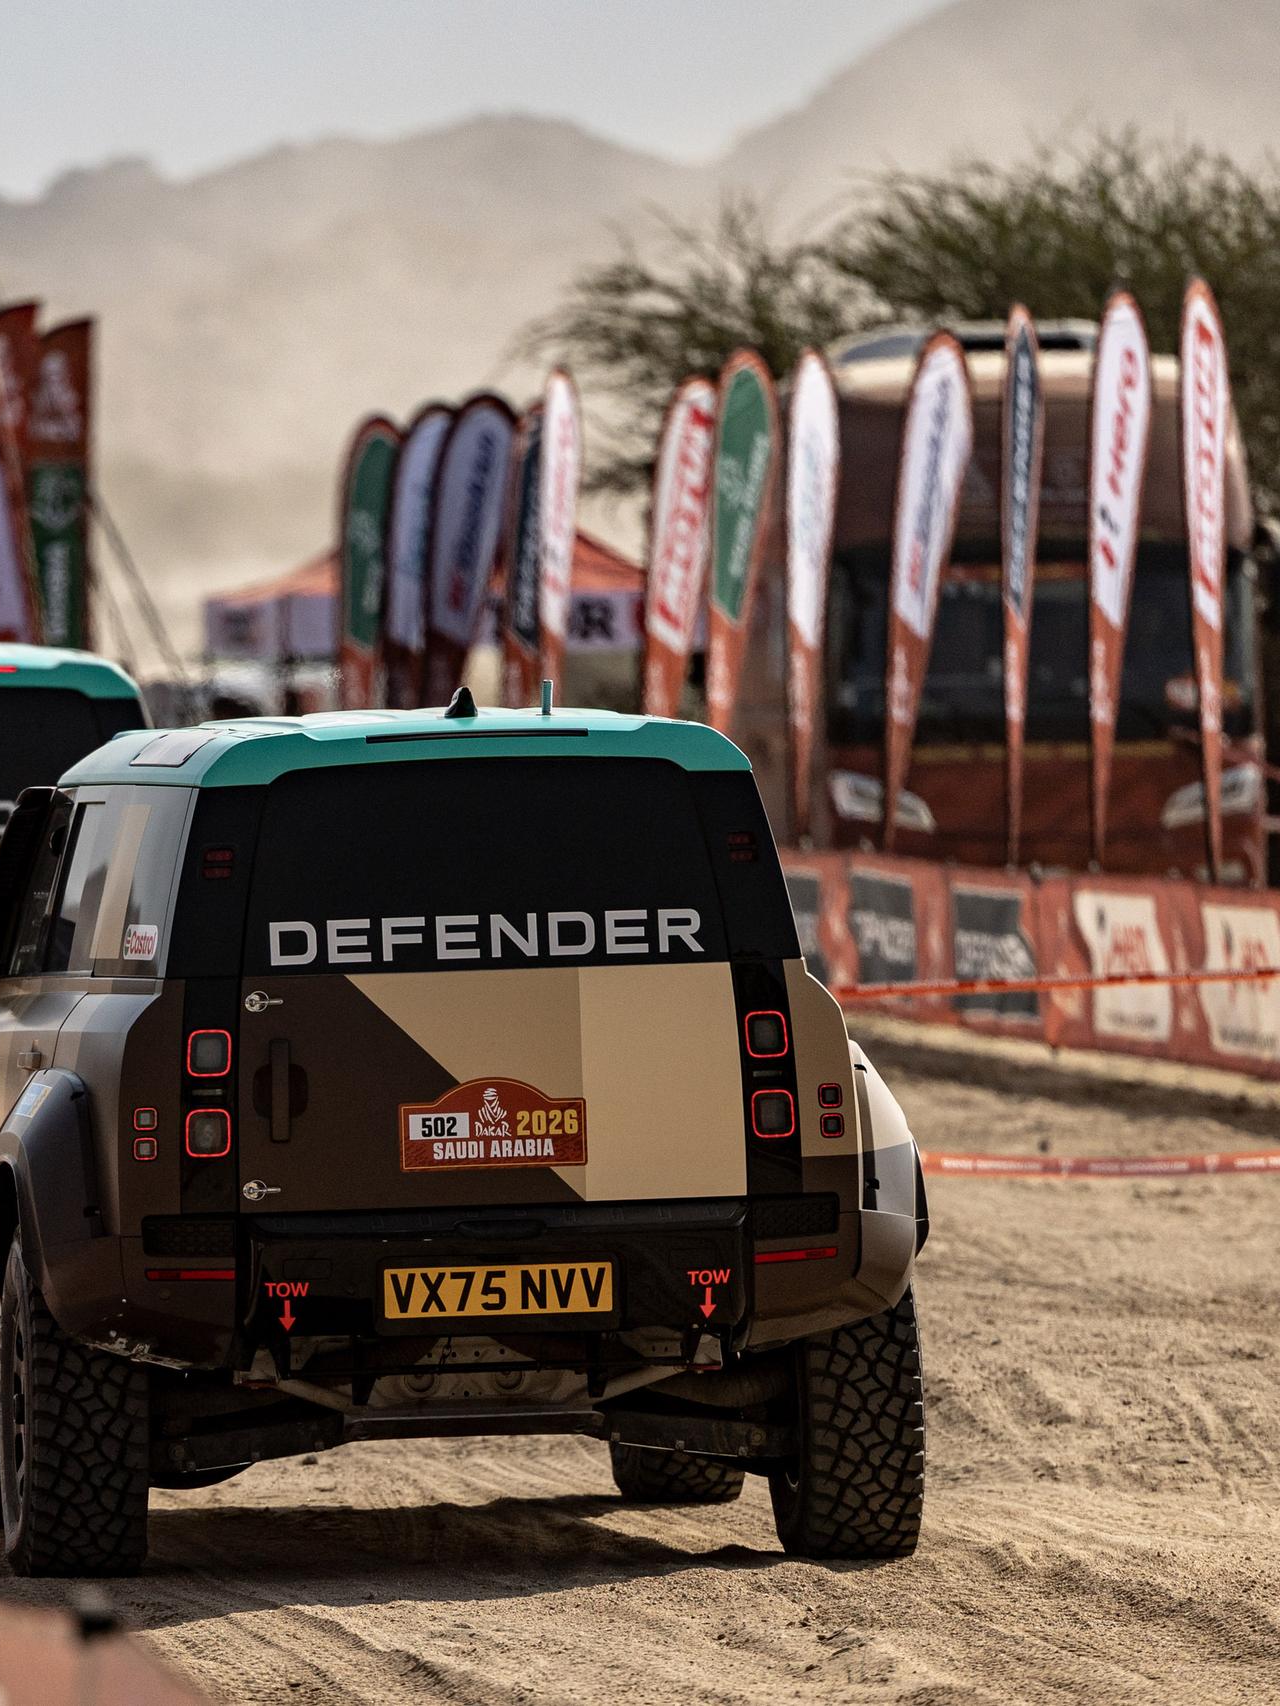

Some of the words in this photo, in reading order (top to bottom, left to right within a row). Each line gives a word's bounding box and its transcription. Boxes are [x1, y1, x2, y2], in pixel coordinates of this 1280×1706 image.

[129, 930, 157, 955] Castrol
[268, 907, 705, 966] DEFENDER
[421, 1116, 458, 1138] 502
[475, 1120, 512, 1137] DAKAR
[516, 1109, 579, 1136] 2026
[433, 1141, 485, 1161] SAUDI
[490, 1138, 555, 1159] ARABIA
[265, 1282, 309, 1297] TOW
[687, 1268, 731, 1286] TOW
[391, 1270, 507, 1314] VX75
[521, 1267, 606, 1310] NVV
